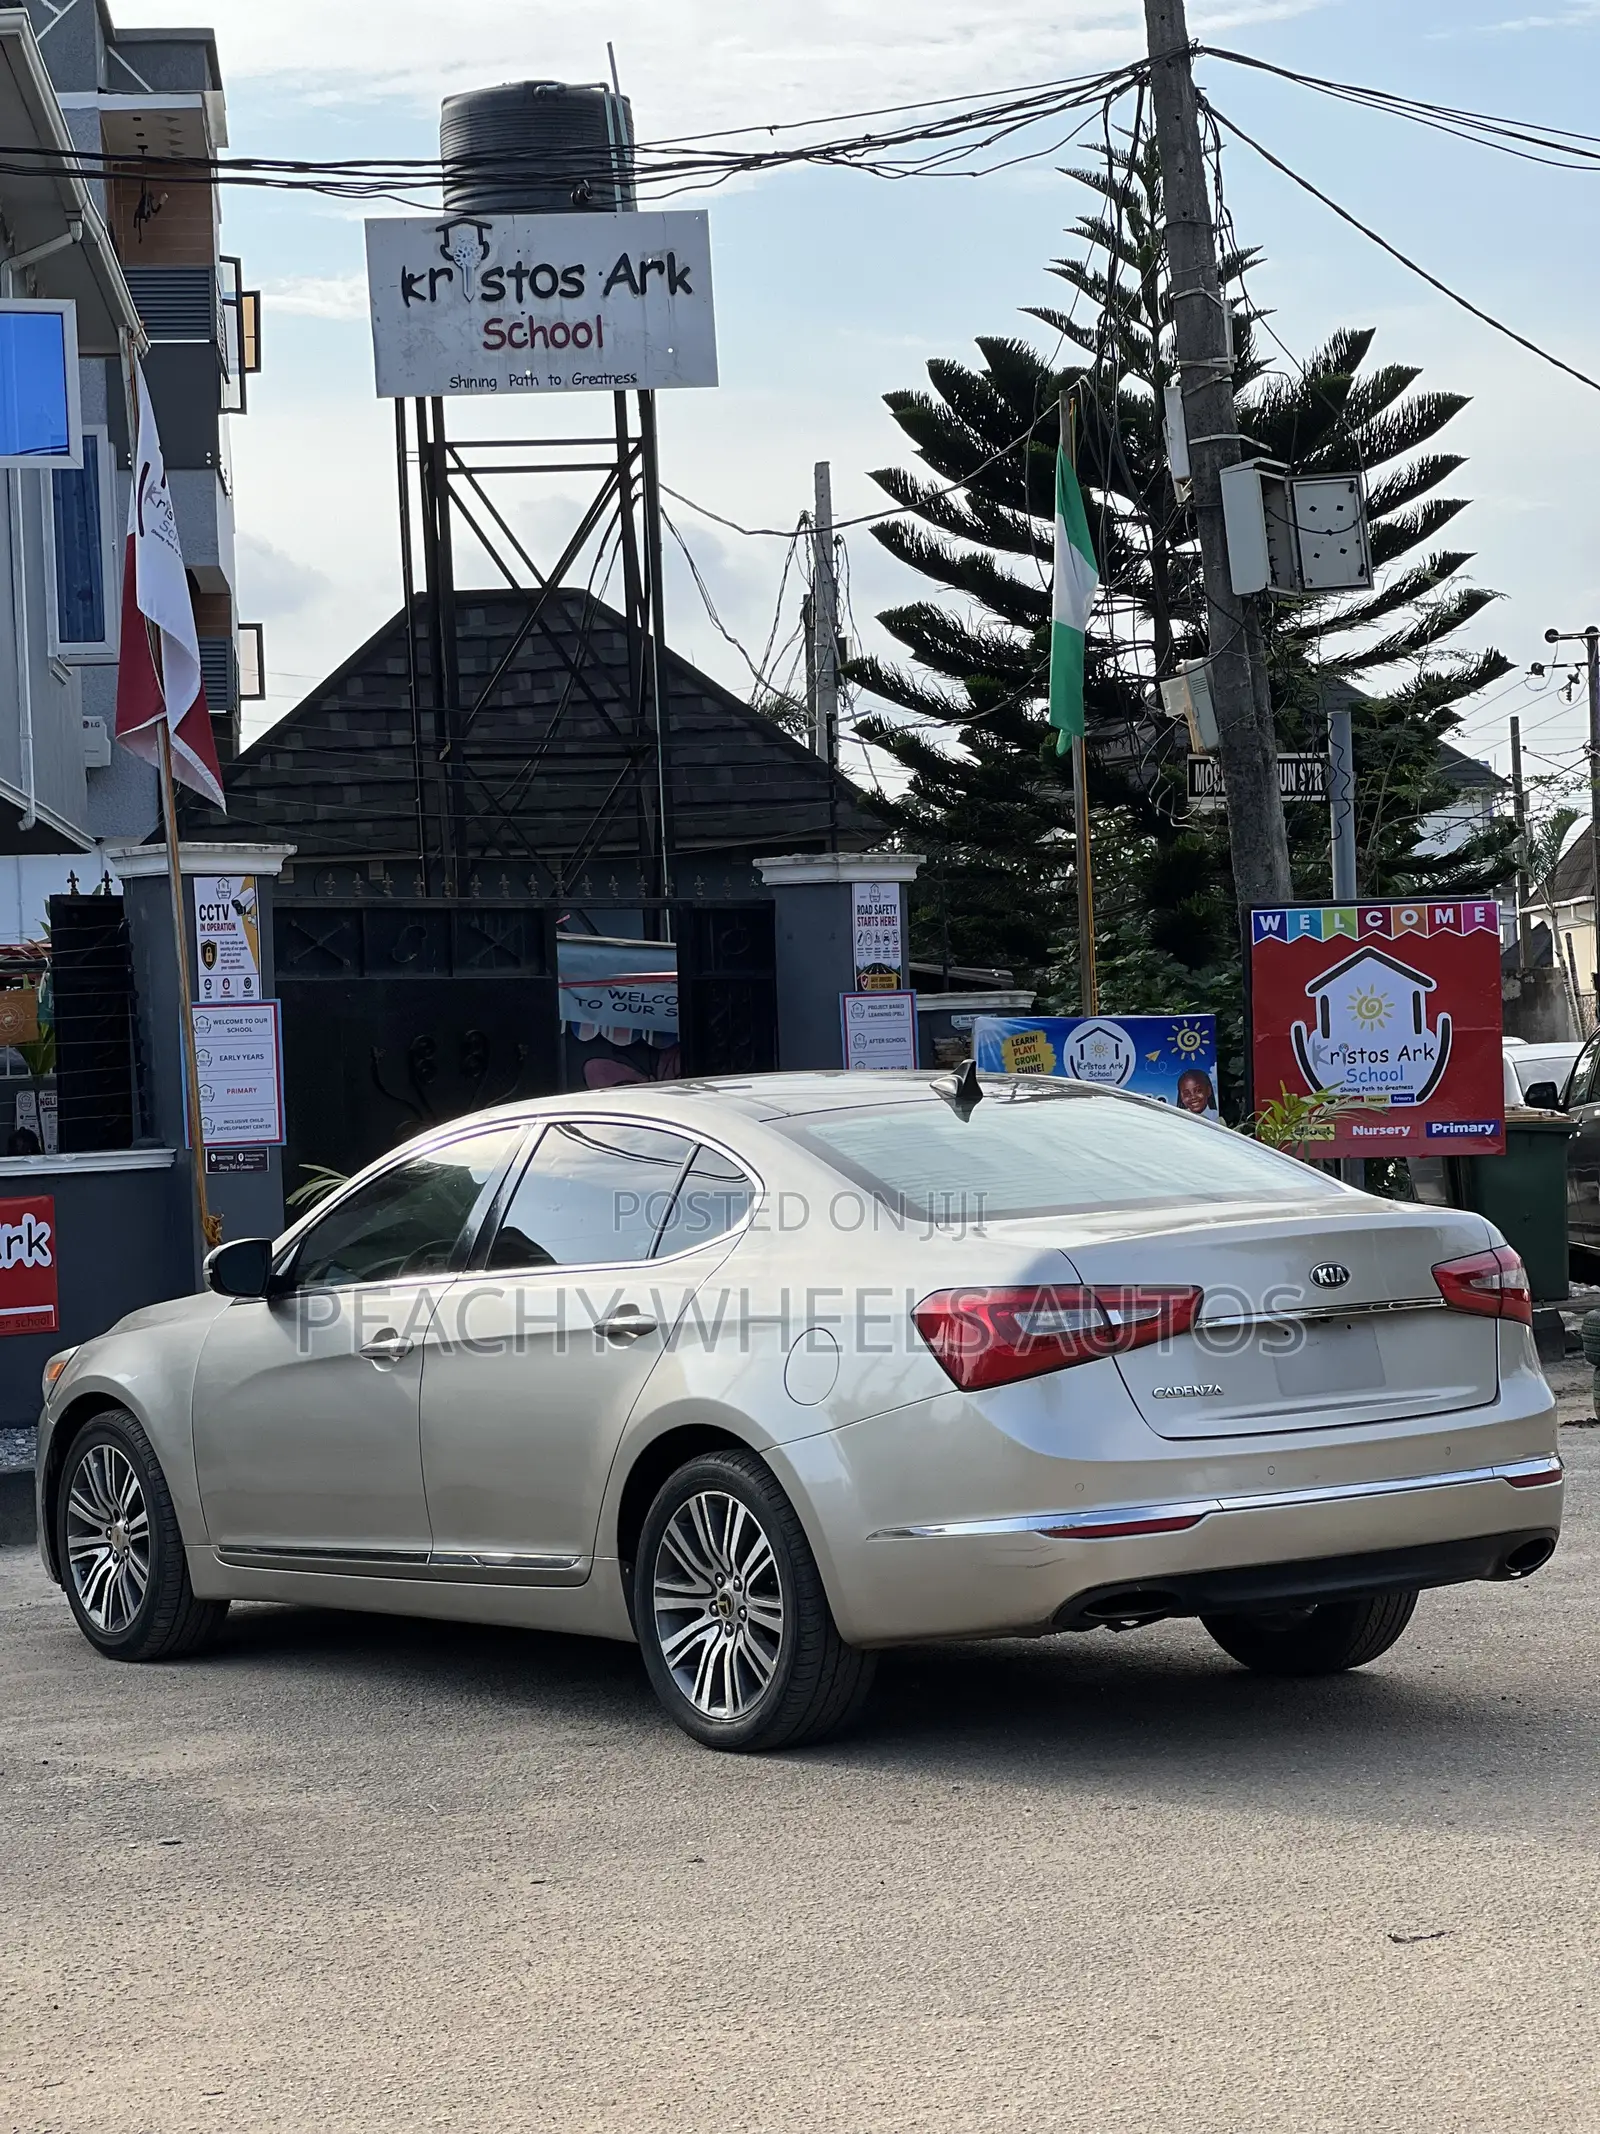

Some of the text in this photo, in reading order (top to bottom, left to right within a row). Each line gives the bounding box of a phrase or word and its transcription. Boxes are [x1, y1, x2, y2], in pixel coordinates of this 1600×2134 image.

[602, 252, 693, 296] Ark
[483, 314, 603, 350] School
[449, 371, 638, 391] Shining Path to Greatness
[199, 903, 229, 921] CCTV
[857, 904, 897, 915] ROAD SAFETY
[857, 916, 898, 927] STARTS HERE!
[1259, 906, 1485, 931] WELCOME
[200, 922, 236, 931] IN OPERATION
[575, 997, 603, 1009] TO
[612, 1002, 655, 1015] OUR
[1011, 1035, 1038, 1047] LEARN!
[1013, 1045, 1036, 1056] PLAY!
[1312, 1039, 1435, 1070] Kristos Ark
[1015, 1054, 1041, 1066] GROW!
[1077, 1061, 1106, 1071] Kristos
[1017, 1063, 1045, 1074] SHINE!
[1346, 1065, 1404, 1083] School
[1352, 1122, 1494, 1136] Nursery Primary
[0, 1222, 47, 1260] rk
[1317, 1266, 1346, 1283] KIA
[15, 1315, 49, 1327] school
[1152, 1384, 1224, 1399] CADENZA
